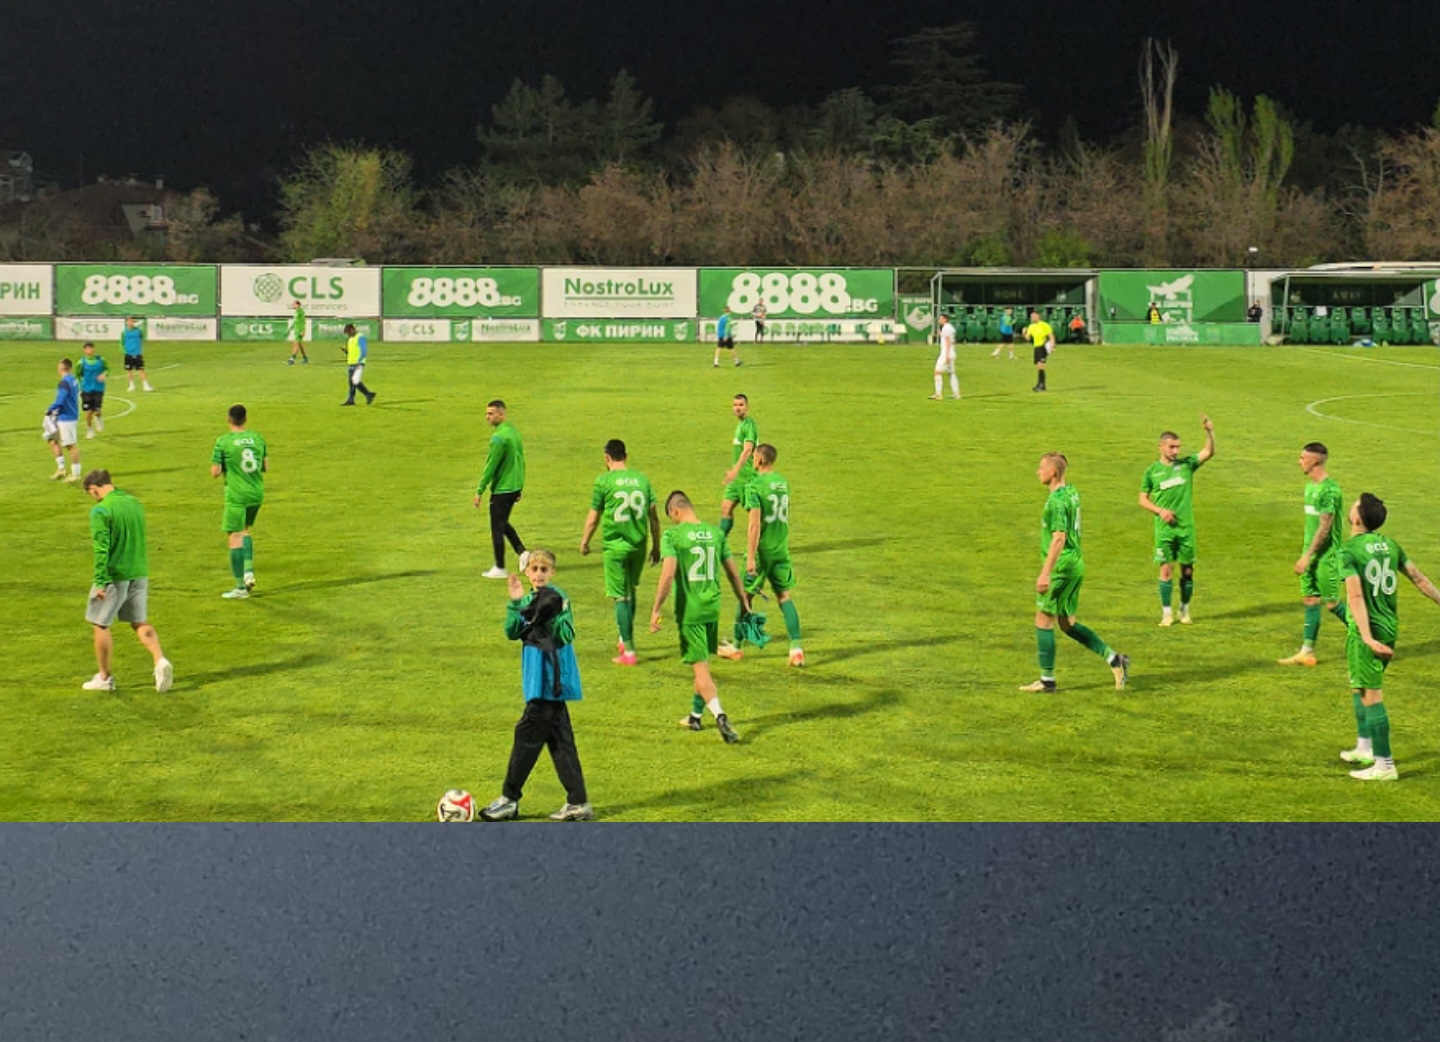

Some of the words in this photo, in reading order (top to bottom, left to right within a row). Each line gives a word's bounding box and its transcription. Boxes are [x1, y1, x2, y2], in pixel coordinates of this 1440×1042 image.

[81, 274, 199, 306] 8888.BG
[288, 276, 344, 300] CLS
[564, 277, 673, 295] NostroLux
[727, 272, 878, 315] 8888.BG
[84, 323, 109, 334] CLS
[249, 323, 274, 335] CLS
[412, 324, 436, 336] CLS
[576, 324, 602, 338] ФК
[606, 324, 666, 338] ПИРИН
[240, 448, 258, 473] 8
[613, 490, 645, 522] 29
[764, 494, 788, 523] 38
[687, 546, 715, 582] 21
[1365, 558, 1396, 597] 96
